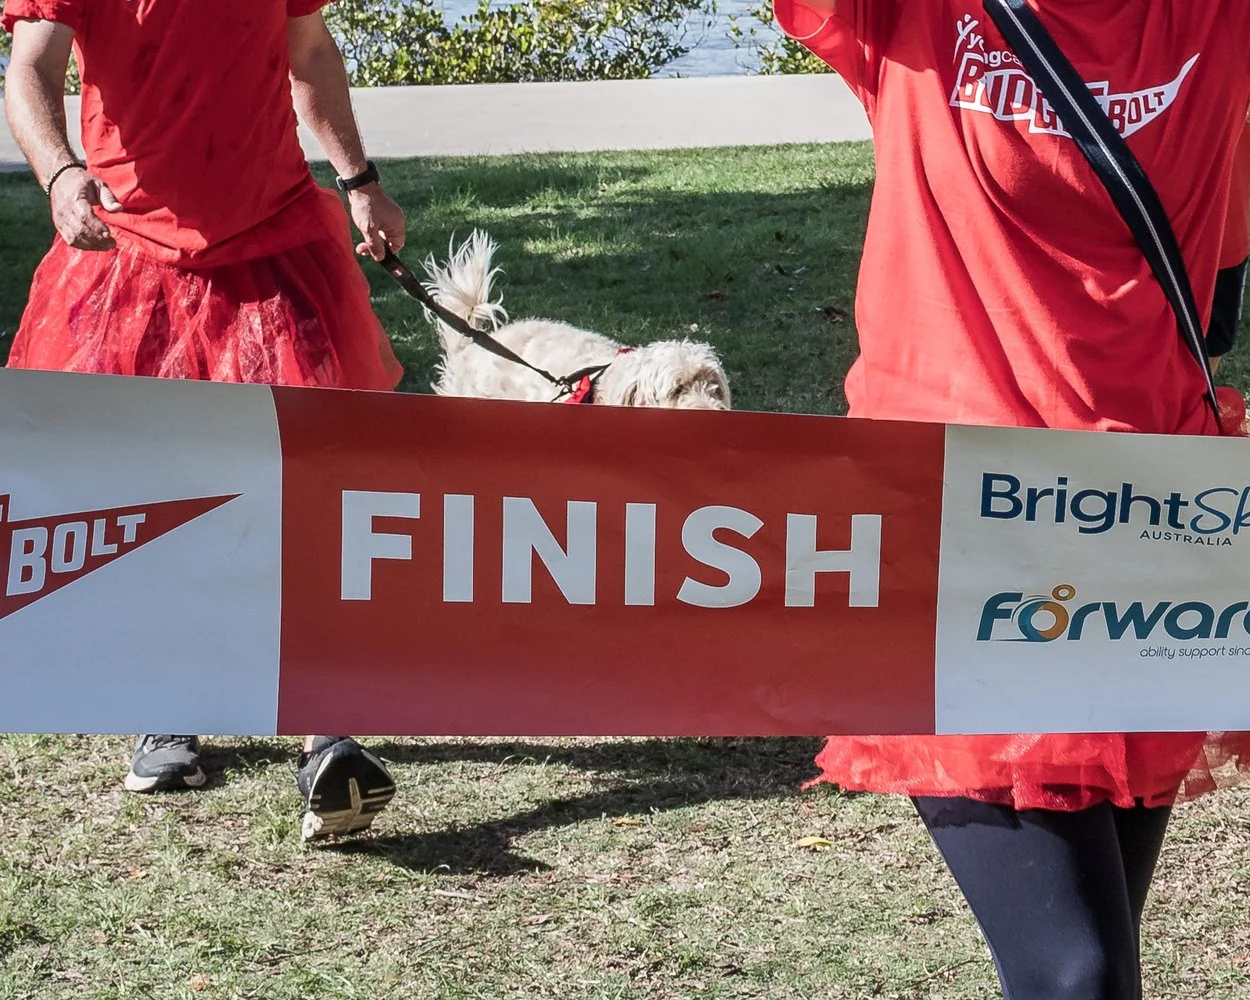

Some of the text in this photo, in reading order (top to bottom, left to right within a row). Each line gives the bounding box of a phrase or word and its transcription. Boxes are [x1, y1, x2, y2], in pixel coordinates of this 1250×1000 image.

[1107, 91, 1165, 135] BOLT
[5, 512, 146, 597] BOLT
[340, 489, 883, 609] FINISH
[1139, 529, 1233, 547] AUSTRALIA
[1139, 645, 1176, 660] ability
[1178, 645, 1226, 660] support
